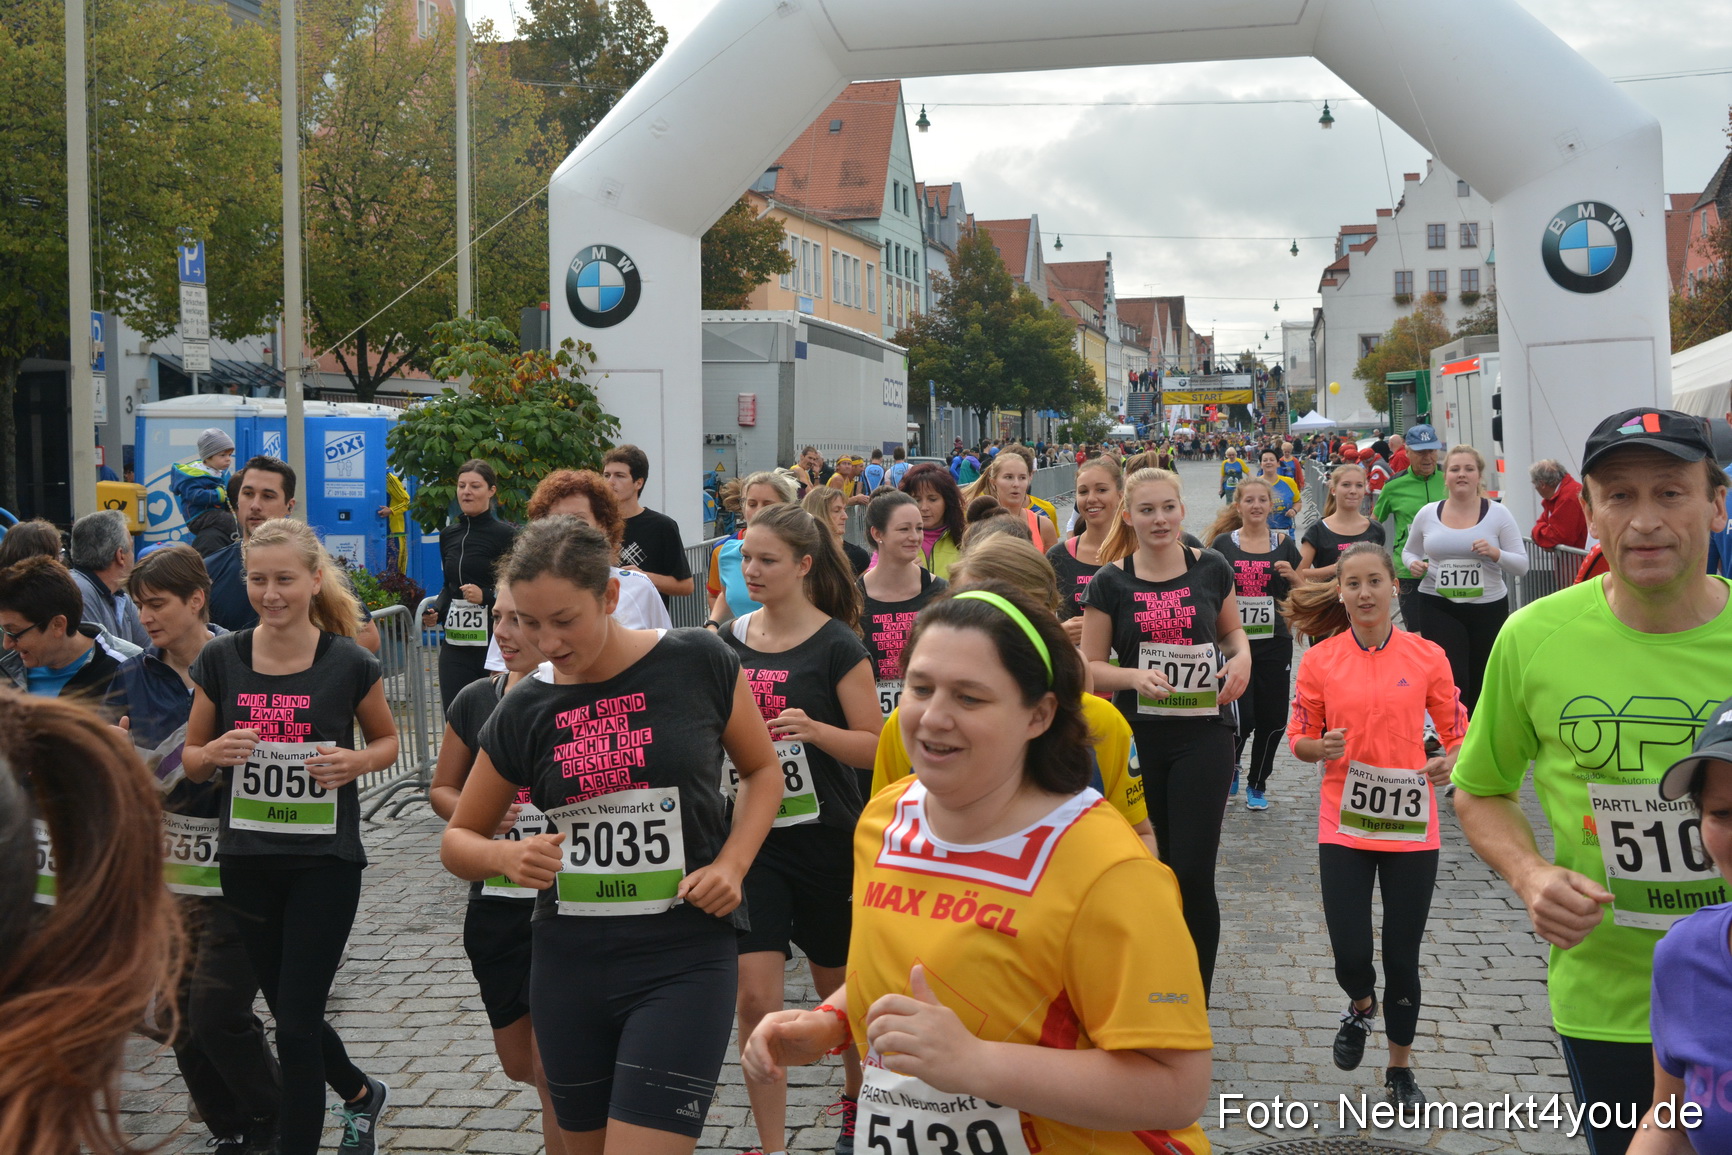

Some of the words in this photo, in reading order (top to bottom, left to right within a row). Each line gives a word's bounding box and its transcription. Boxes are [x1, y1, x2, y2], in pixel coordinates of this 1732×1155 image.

[1548, 203, 1626, 236] BMW
[570, 246, 635, 274] BMW
[125, 396, 134, 414] 3
[1191, 393, 1223, 402] START
[1440, 570, 1480, 586] 5170
[1134, 592, 1158, 602] WIR
[1161, 587, 1191, 600] SIND
[1147, 600, 1181, 610] ZWAR
[448, 611, 483, 628] 5125
[1135, 609, 1170, 622] NICHT
[1175, 606, 1197, 617] DIE
[1240, 608, 1270, 624] 175
[872, 631, 902, 641] NICHT
[1152, 629, 1182, 640] ABER
[1141, 648, 1166, 657] PARTL
[1168, 651, 1204, 660] Neumarkt
[757, 670, 788, 682] SIND
[238, 694, 267, 706] WIR
[272, 694, 310, 708] SIND
[765, 695, 786, 707] DIE
[251, 708, 294, 721] ZWAR
[556, 705, 590, 729] WIR
[596, 693, 646, 717] SIND
[284, 722, 311, 734] DIE
[572, 714, 629, 740] ZWAR
[554, 735, 610, 761] NICHT
[617, 727, 652, 750] DIE
[271, 752, 319, 760] Neumarkt
[562, 747, 645, 778] BESTEN,
[579, 767, 631, 792] ABER
[1349, 767, 1375, 781] PARTL
[1377, 776, 1416, 785] Neumarkt
[1350, 781, 1422, 817] 5013
[1592, 798, 1643, 812] PARTL
[267, 807, 297, 822] Anja
[552, 806, 597, 820] PARTL
[599, 802, 655, 814] Neumarkt
[1361, 817, 1405, 831] Theresa
[570, 819, 671, 868] 5035
[596, 880, 637, 898] Julia
[1647, 885, 1728, 909] Helmut
[863, 881, 927, 916] MAX
[930, 889, 1018, 938] BÖGL
[861, 1084, 899, 1105] PARTL
[900, 1093, 978, 1114] Neumarkt
